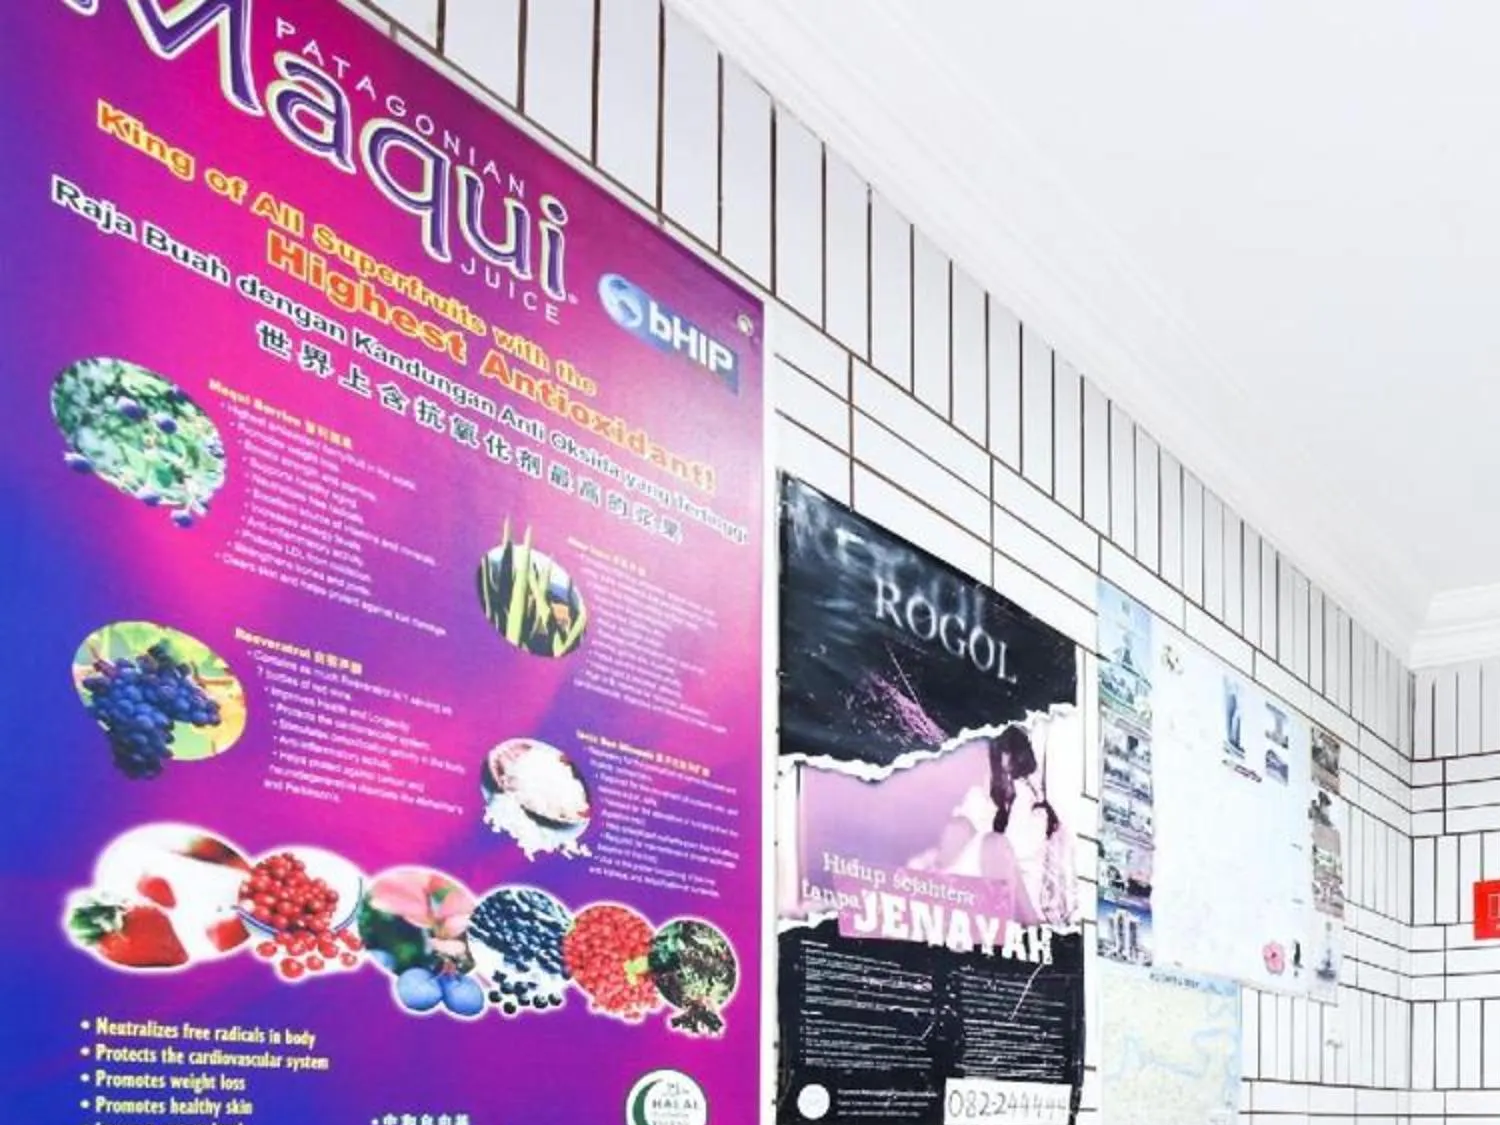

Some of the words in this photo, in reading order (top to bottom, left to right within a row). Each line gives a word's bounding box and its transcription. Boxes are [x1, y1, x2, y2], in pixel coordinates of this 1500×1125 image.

[275, 17, 525, 198] PATAGONIAN
[97, 98, 195, 181] King
[205, 168, 248, 204] of
[249, 192, 303, 236] All
[313, 223, 487, 336] Superfruits
[492, 325, 550, 372] with
[555, 358, 597, 396] the
[52, 174, 137, 242] Raja
[142, 220, 230, 288] Buah
[236, 271, 348, 344] dengan
[351, 328, 497, 418] Kandungan
[500, 404, 545, 441] Anti
[460, 256, 560, 325] JUICE
[267, 229, 467, 365] Highest
[479, 349, 716, 491] Antioxidant!
[650, 301, 734, 374] bHIP
[873, 576, 1018, 685] ROGOL
[822, 851, 886, 889] Hidup
[854, 890, 1053, 966] JENAYAH
[95, 1017, 178, 1039] Neutralizes
[182, 1022, 210, 1040] free
[214, 1025, 266, 1044] radicals
[268, 1028, 282, 1044] in
[285, 1029, 316, 1049] body
[95, 1043, 157, 1063] Protects
[162, 1046, 185, 1064] the
[188, 1049, 282, 1069] cardiovascular
[286, 1054, 329, 1071] system
[95, 1070, 166, 1089] Promotes
[170, 1072, 216, 1094] weight
[220, 1074, 246, 1091] loss
[95, 1095, 166, 1114] Promotes
[169, 1096, 222, 1118] healthy
[226, 1098, 253, 1115] skin
